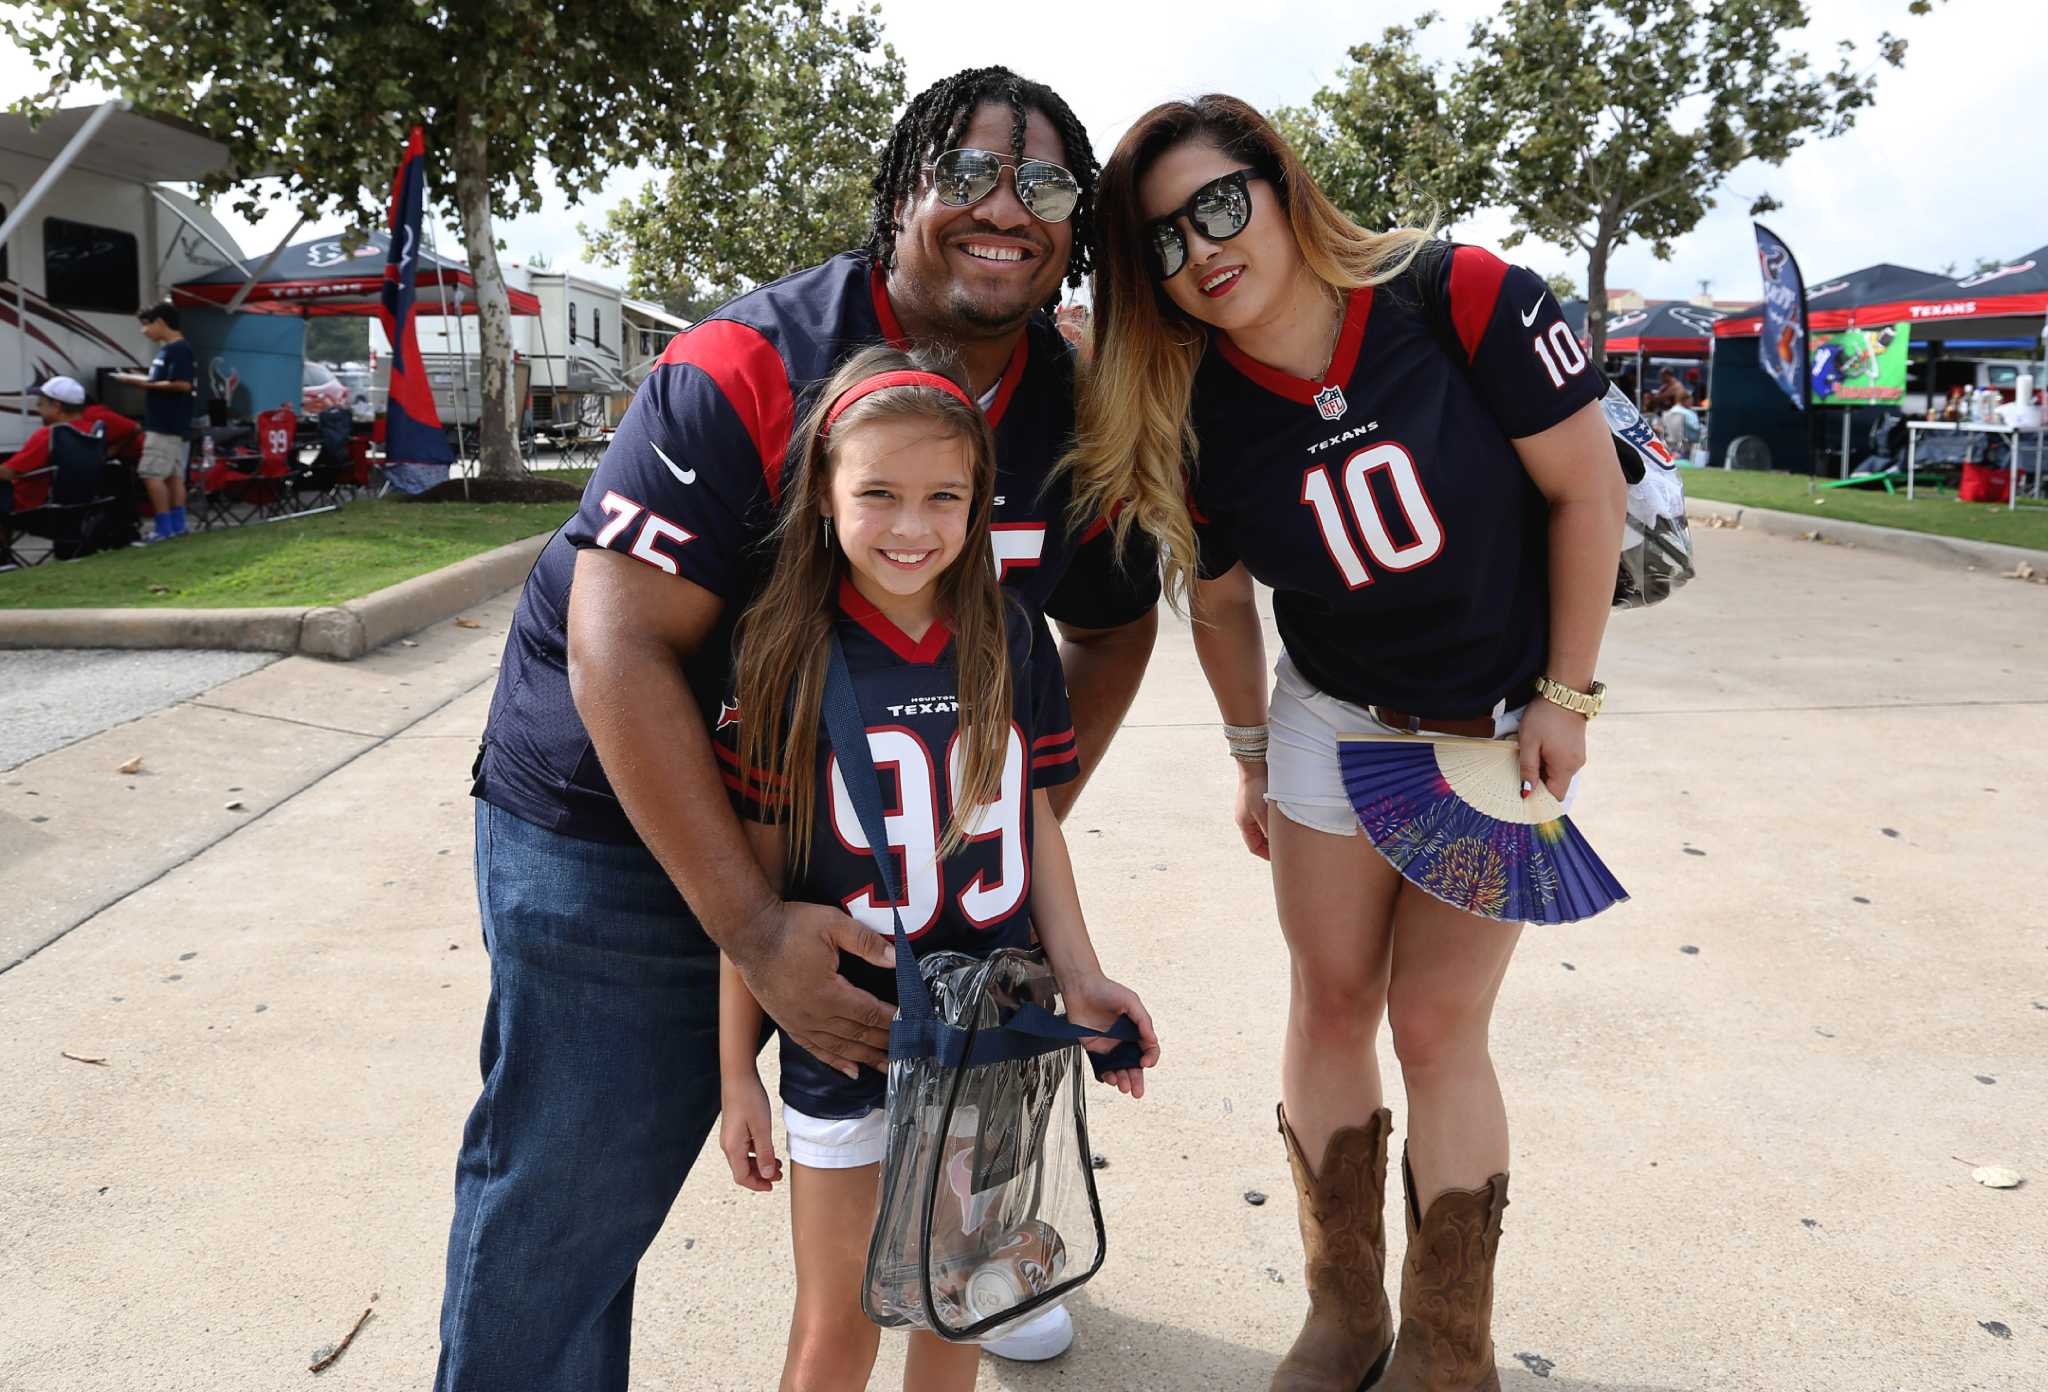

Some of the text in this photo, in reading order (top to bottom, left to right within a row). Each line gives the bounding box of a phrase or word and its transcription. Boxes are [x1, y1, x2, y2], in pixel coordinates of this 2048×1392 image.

[269, 283, 362, 298] TEXANS
[1909, 301, 1976, 318] TEXANS
[1534, 320, 1587, 389] 10
[1321, 399, 1344, 416] NFL
[268, 429, 288, 454] 99
[1306, 421, 1379, 455] TEXANS
[1300, 440, 1445, 591] 10
[593, 489, 699, 575] 75
[886, 701, 960, 717] TEXAN
[910, 695, 956, 703] HOUSTON
[826, 721, 1031, 942] 99
